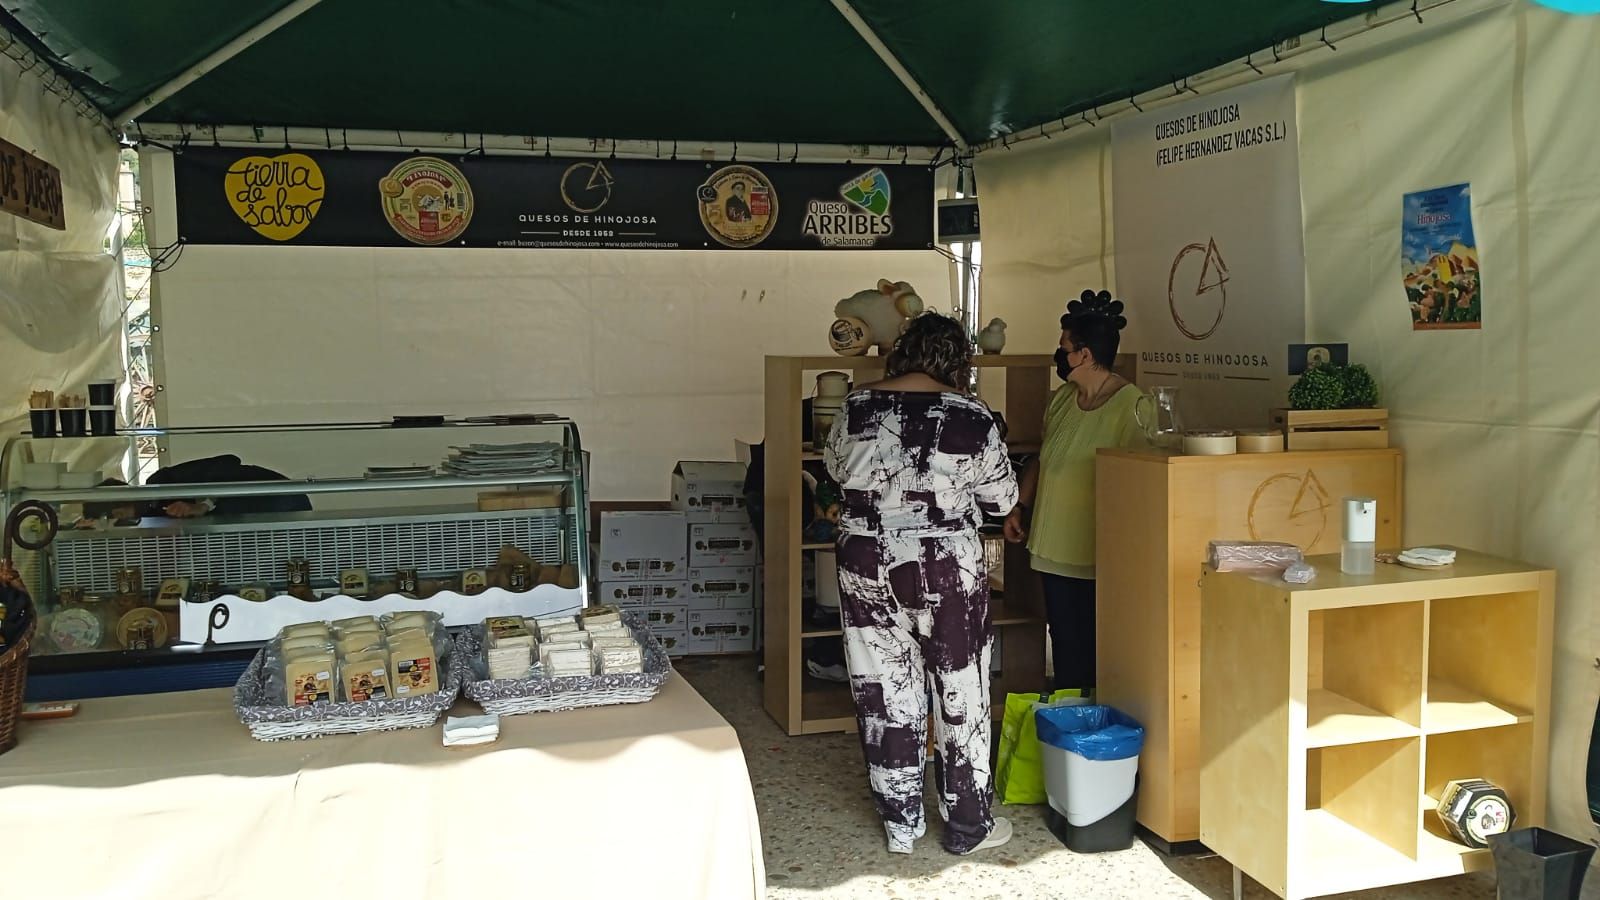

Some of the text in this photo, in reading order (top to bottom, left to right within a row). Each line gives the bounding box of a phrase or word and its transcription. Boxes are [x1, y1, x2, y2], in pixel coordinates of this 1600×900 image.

[1155, 103, 1240, 141] QUESOS DE HINOJOSA
[1156, 144, 1184, 168] (FELIPE
[1185, 133, 1233, 160] HERNANDEZ
[1234, 125, 1263, 150] VACAS
[227, 161, 323, 191] tierra
[236, 187, 267, 203] de
[243, 187, 325, 228] sabor
[809, 200, 848, 217] Queso
[518, 214, 657, 224] QUESOS DE HINOJOSA
[803, 214, 892, 235] ARRIBES
[563, 229, 591, 237] DESDE
[817, 236, 875, 247] de Salamanca
[1142, 351, 1269, 367] QUESOS DE HINOJOSA
